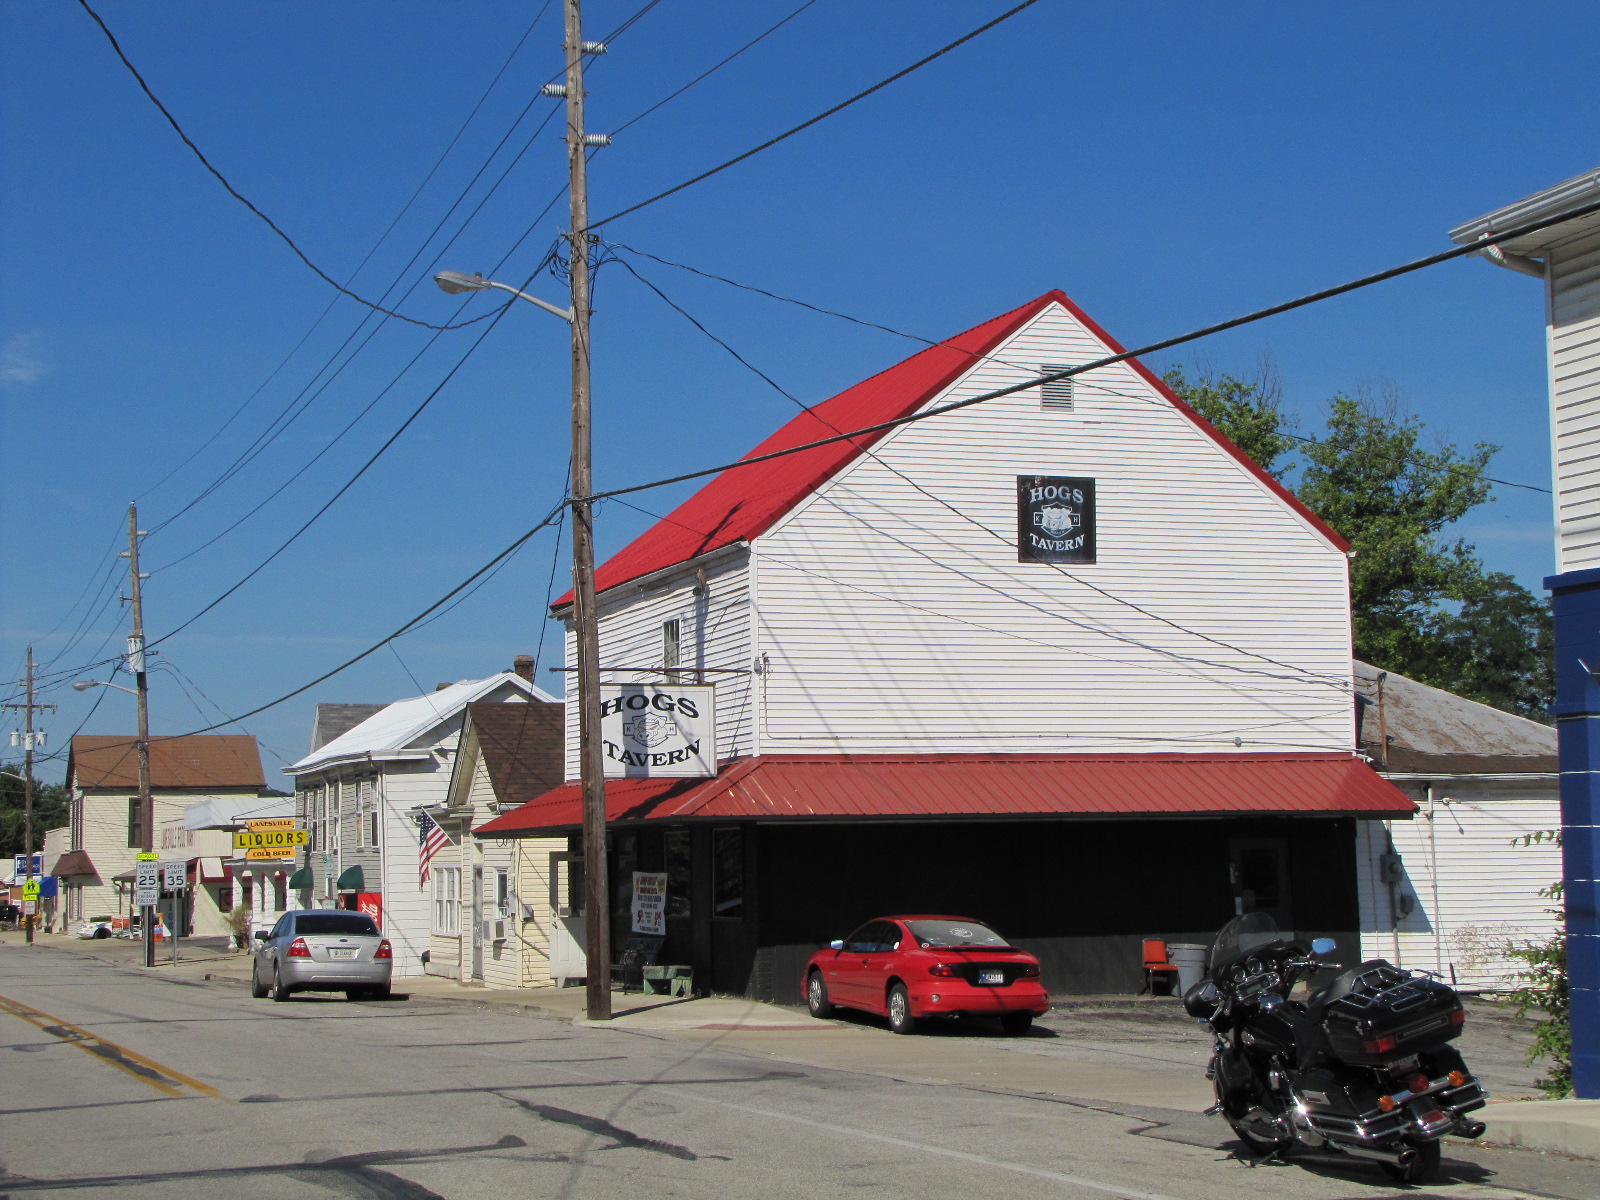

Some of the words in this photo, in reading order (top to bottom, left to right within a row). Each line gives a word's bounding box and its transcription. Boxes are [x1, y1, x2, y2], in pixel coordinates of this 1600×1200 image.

[1029, 485, 1084, 504] HOGS
[1029, 532, 1085, 551] TAVERN
[600, 693, 699, 719] HOGS
[603, 738, 700, 767] TAVERN
[250, 820, 293, 828] LANESVILLE
[239, 832, 304, 846] LIQUORS
[138, 875, 156, 886] 25
[167, 875, 184, 886] 35
